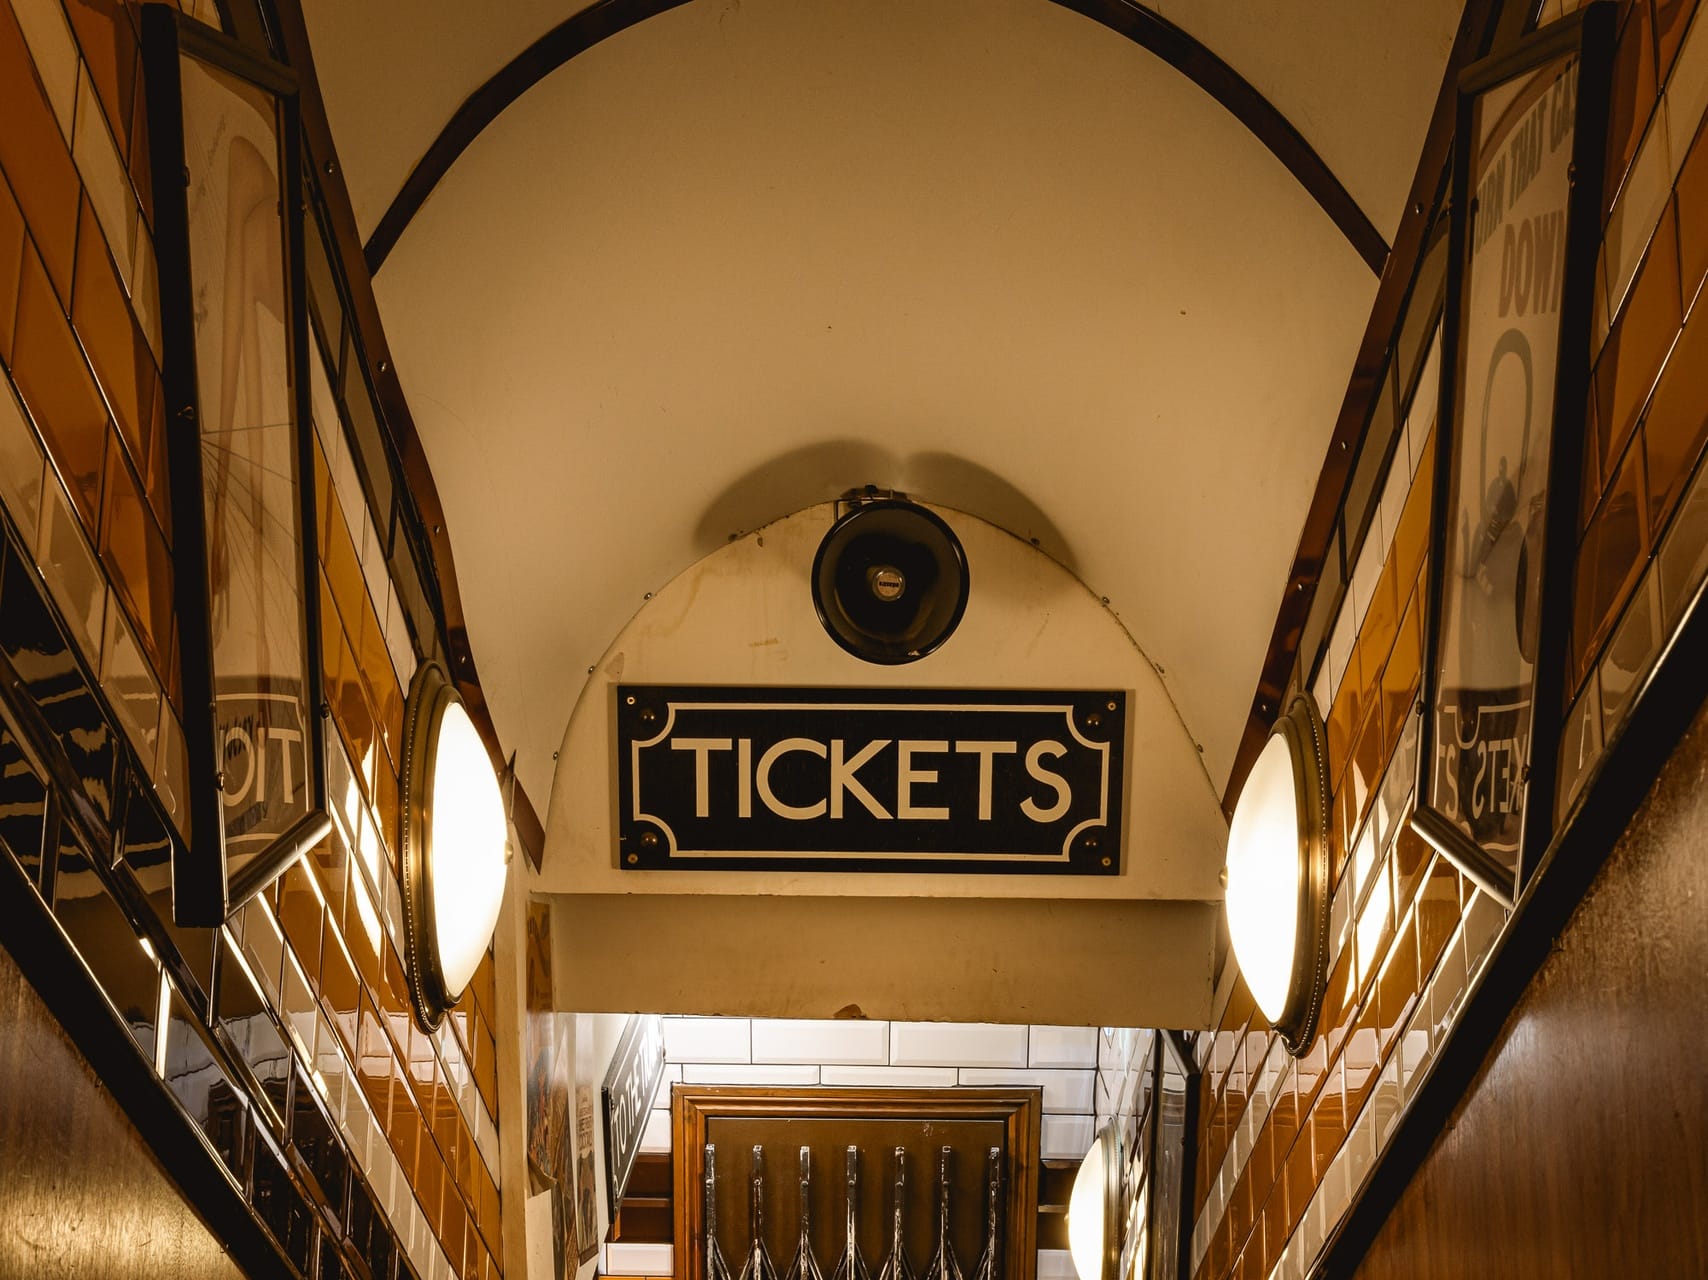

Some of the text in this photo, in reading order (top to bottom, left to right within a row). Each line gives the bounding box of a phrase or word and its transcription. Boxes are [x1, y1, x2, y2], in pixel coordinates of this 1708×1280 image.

[1474, 151, 1507, 254] URN
[1509, 95, 1547, 211] THAT
[671, 736, 1073, 824] TICKETS
[610, 1052, 642, 1168] TO THE
